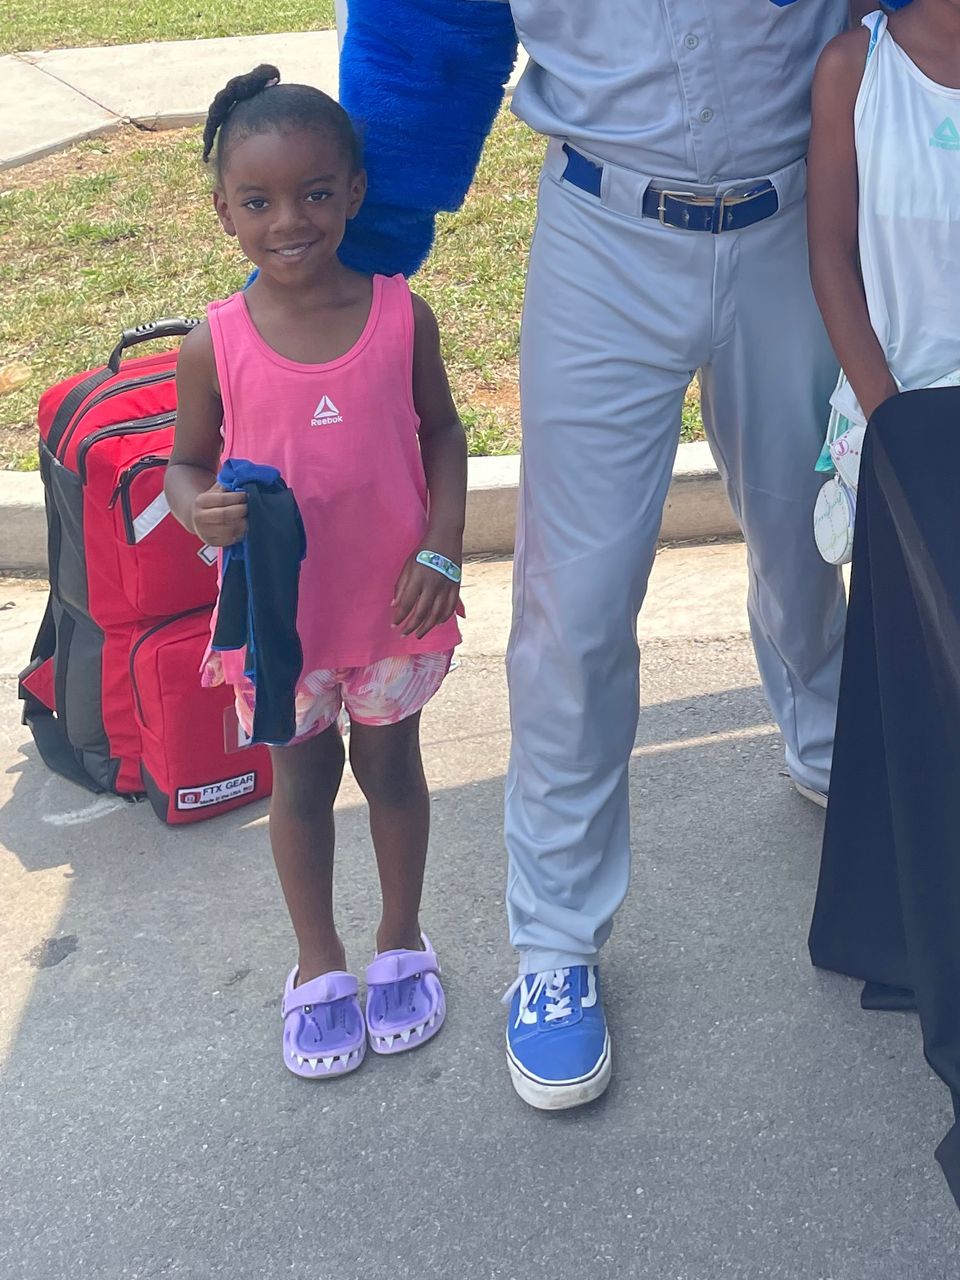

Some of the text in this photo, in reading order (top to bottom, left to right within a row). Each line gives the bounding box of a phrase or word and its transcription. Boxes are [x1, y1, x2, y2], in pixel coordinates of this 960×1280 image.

[310, 415, 344, 427] Reebok
[203, 785, 222, 796] FTX
[226, 775, 253, 789] GEAR
